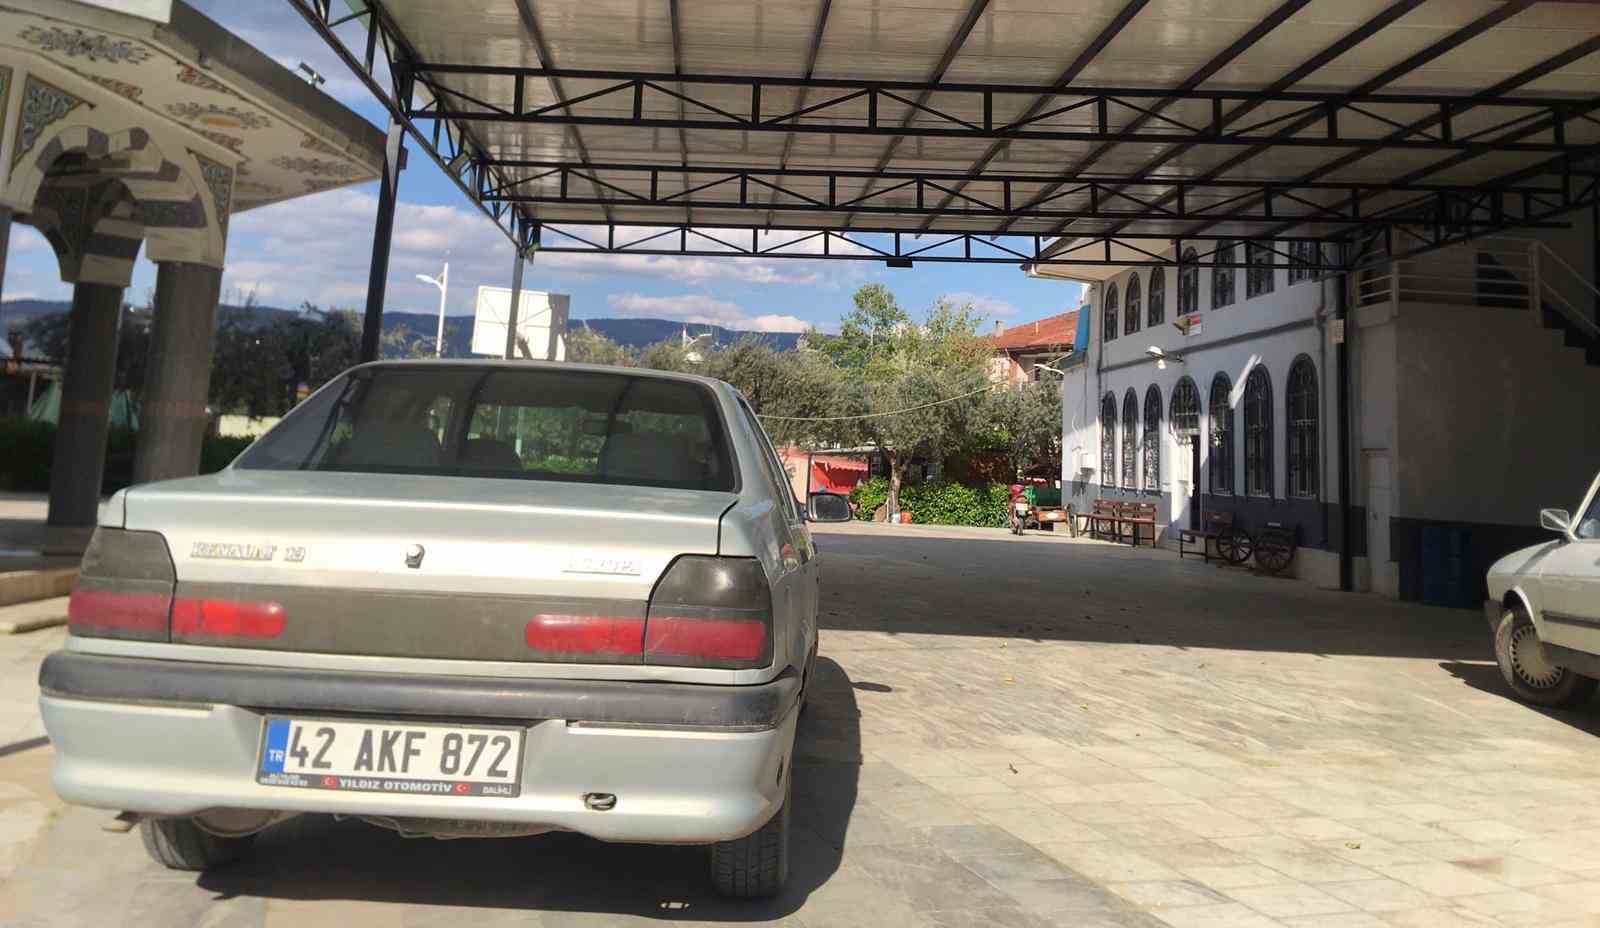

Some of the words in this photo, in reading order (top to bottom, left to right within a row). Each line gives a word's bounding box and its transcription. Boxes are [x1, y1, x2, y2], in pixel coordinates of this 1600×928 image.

[269, 750, 283, 762] TR
[290, 726, 336, 769] 42
[354, 729, 426, 773] AKF
[440, 733, 511, 777] 872
[340, 778, 379, 790] YILDIZ
